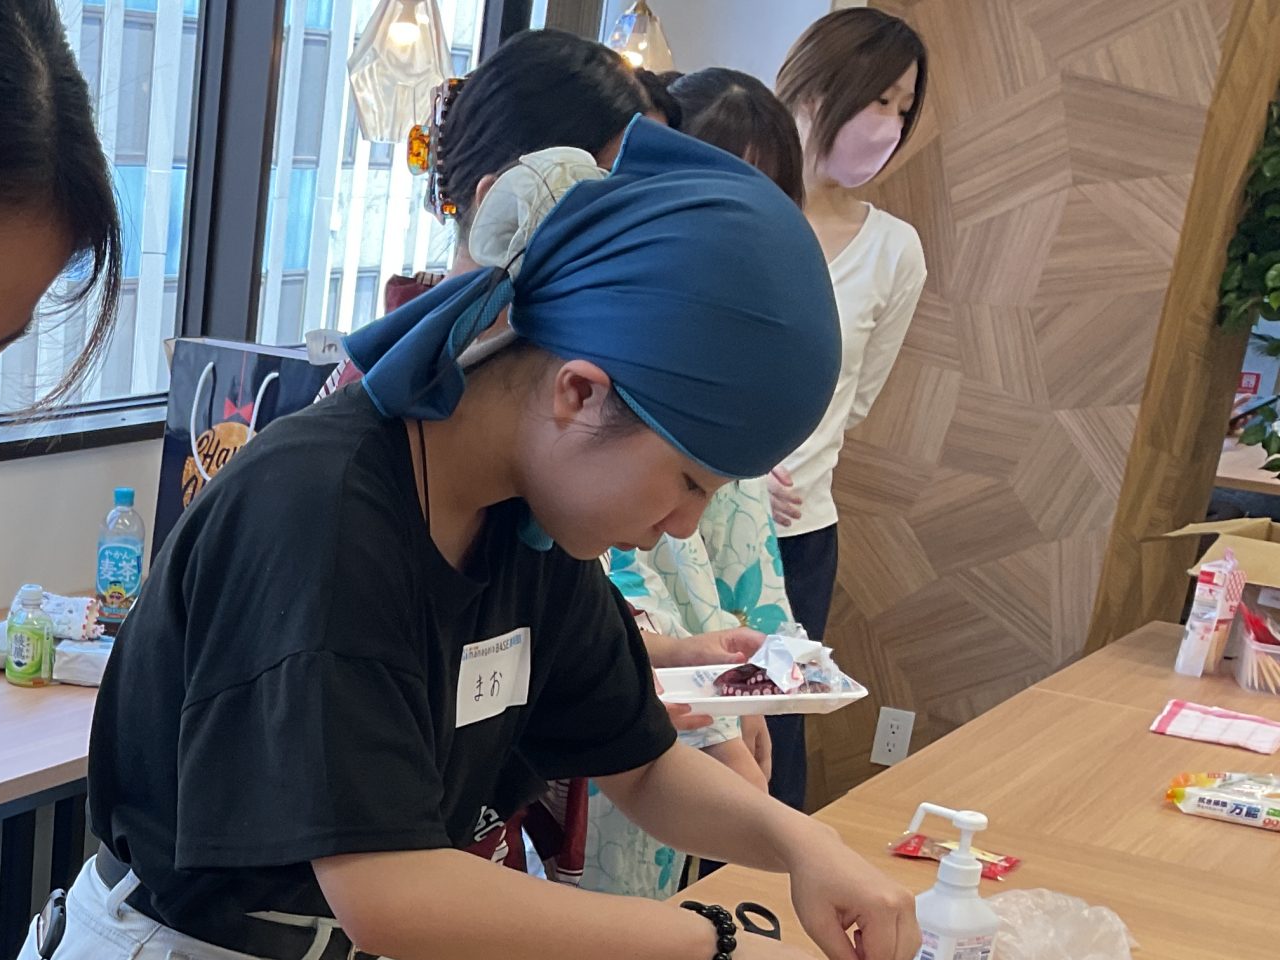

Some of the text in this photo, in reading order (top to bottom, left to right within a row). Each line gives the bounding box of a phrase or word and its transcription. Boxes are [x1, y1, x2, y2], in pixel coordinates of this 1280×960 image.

[104, 549, 129, 560] やかん
[100, 557, 137, 582] 麦茶
[474, 671, 503, 702] まお
